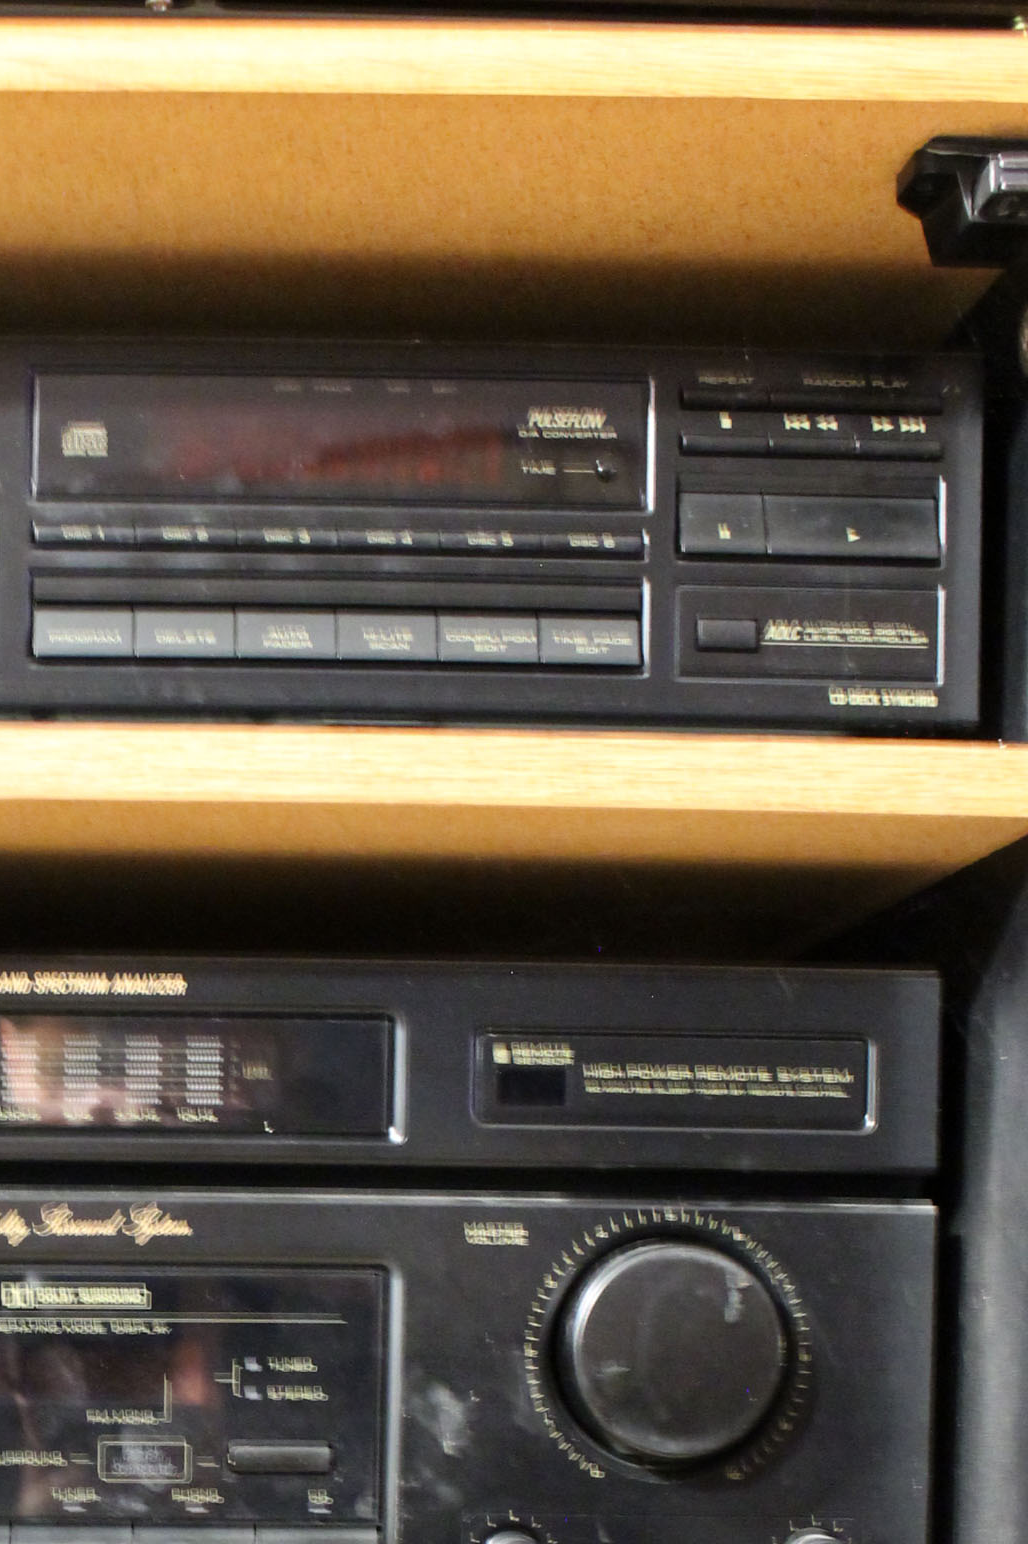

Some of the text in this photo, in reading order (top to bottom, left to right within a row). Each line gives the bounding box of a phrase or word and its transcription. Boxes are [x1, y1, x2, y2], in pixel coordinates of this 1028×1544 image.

[698, 372, 755, 385] REPEAT
[802, 375, 908, 389] RANDOM PLAY
[526, 406, 609, 429] PULSEFLOW
[543, 426, 618, 440] CONVERTER
[521, 459, 556, 476] TIME
[804, 620, 873, 636] AUTOMATIC
[47, 628, 122, 645] PROGRAM
[155, 628, 218, 645] DELETE
[847, 632, 930, 645] CONTROLLER
[33, 972, 112, 996] SPECTRUM
[110, 973, 188, 996] ANALYZER
[510, 1042, 574, 1057] REMOTE
[582, 1063, 854, 1083] HIGH POWER REMOTE SYSTEM
[746, 1083, 795, 1097] REMOTE
[795, 1084, 851, 1098] CONTROL
[32, 1202, 127, 1237] Surround
[464, 1221, 529, 1237] MASTER
[465, 1231, 529, 1246] VOLUME
[37, 1287, 144, 1305] DOLBY SURROUND
[61, 1318, 108, 1335] MODE
[110, 1318, 172, 1336] DISPLAY
[266, 1385, 329, 1402] STEREO
[171, 1488, 225, 1504] PHONO
[308, 1488, 334, 1504] CD
